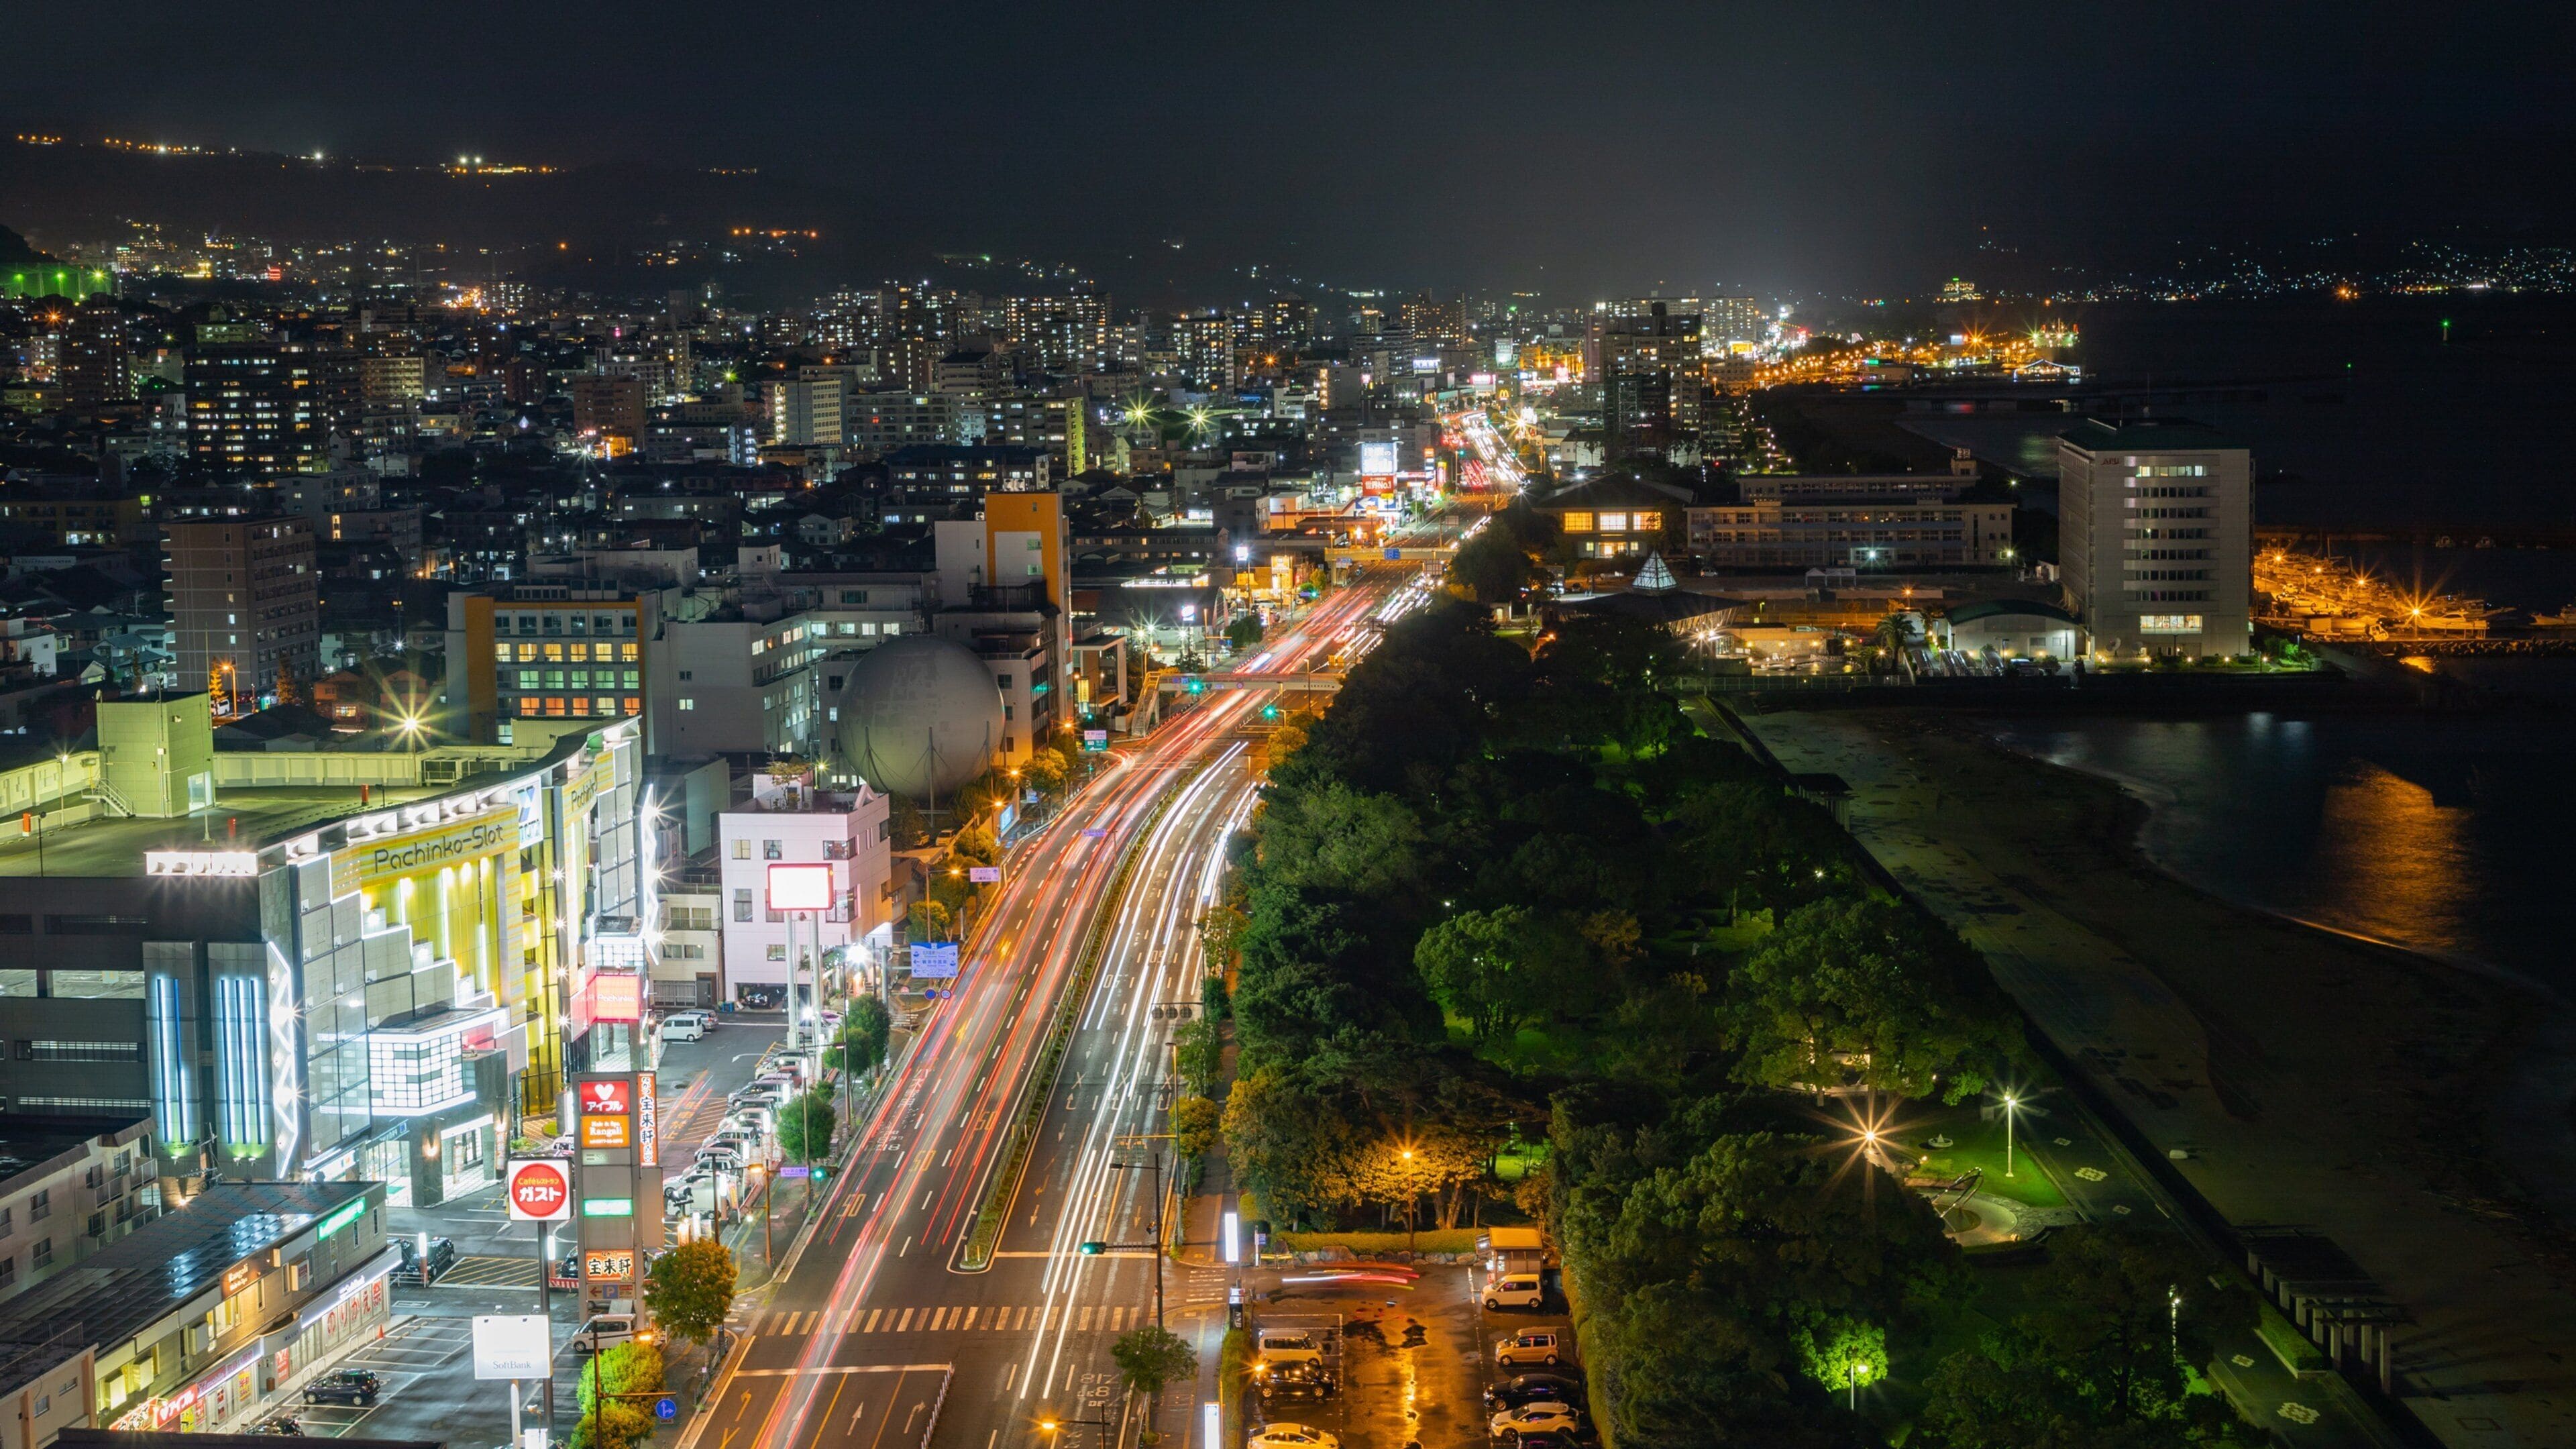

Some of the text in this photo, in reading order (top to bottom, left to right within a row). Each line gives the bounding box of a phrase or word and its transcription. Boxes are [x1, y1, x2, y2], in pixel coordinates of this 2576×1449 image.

[374, 824, 504, 873] Pachinko-Slot
[586, 1101, 624, 1112] アイフル
[519, 1187, 562, 1203] ガスト
[589, 1258, 631, 1275] 宝来軒
[493, 1360, 531, 1370] SoftBank
